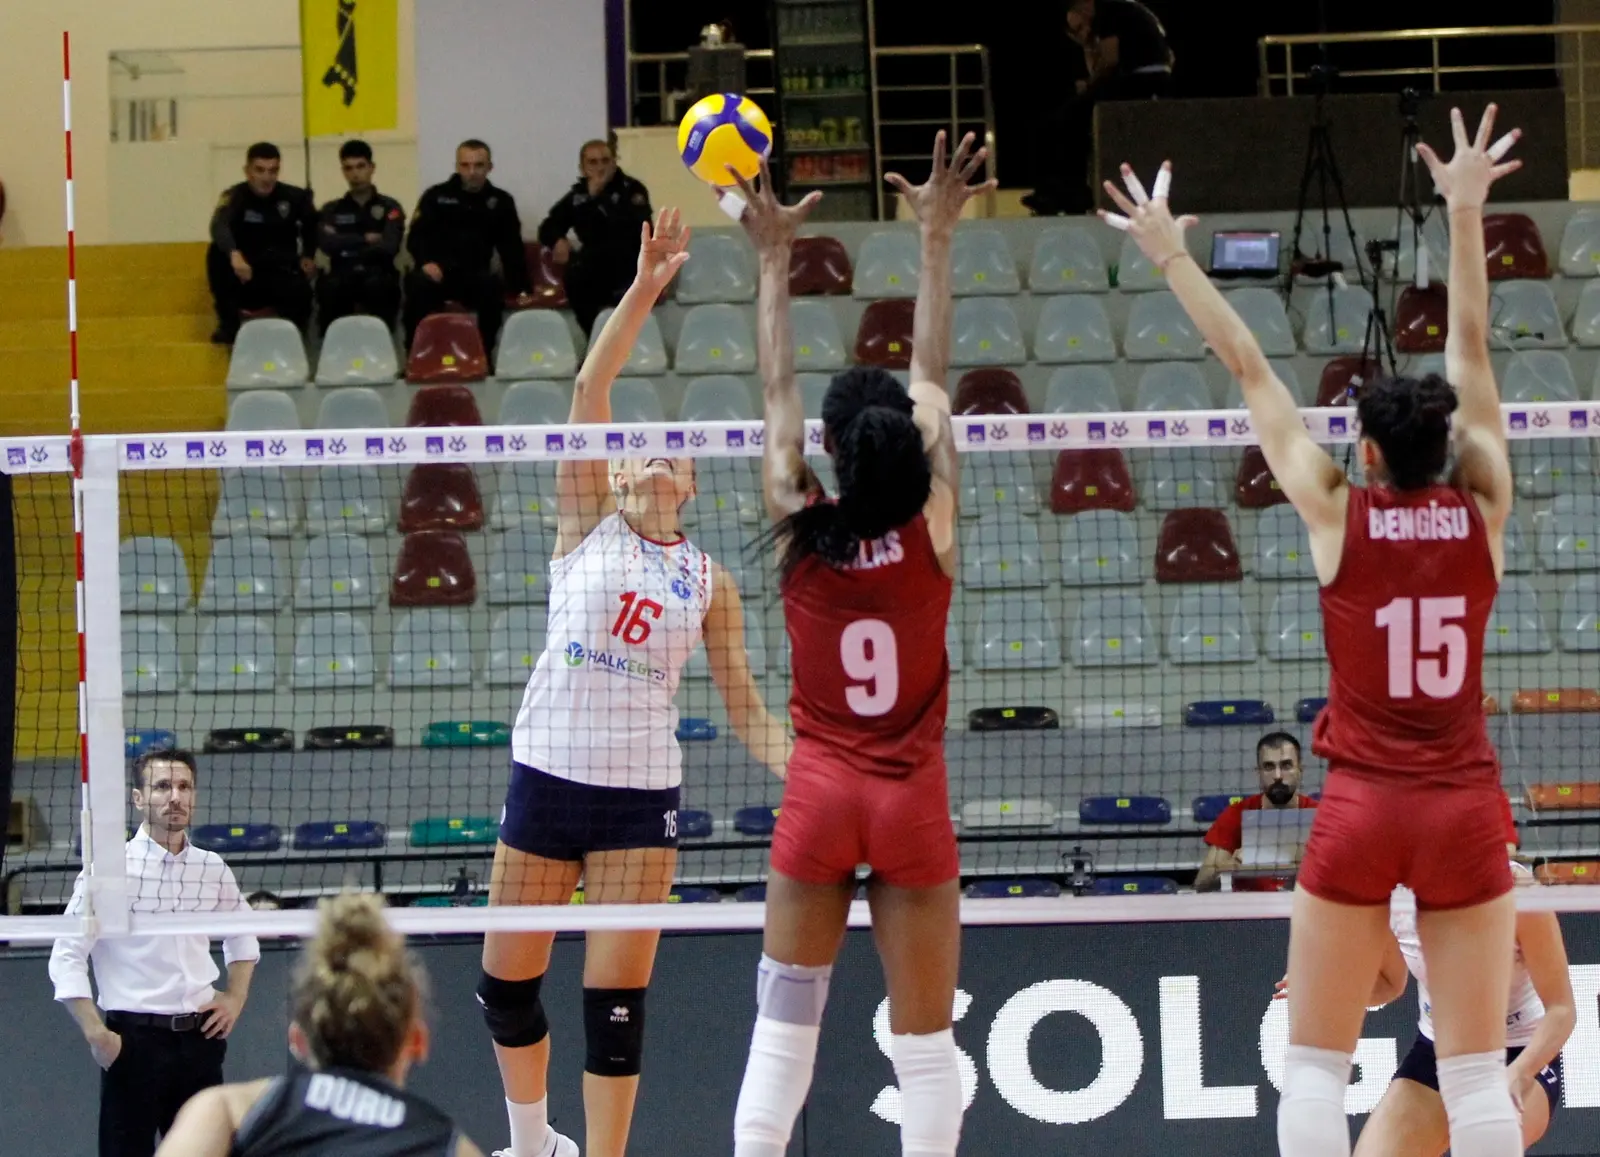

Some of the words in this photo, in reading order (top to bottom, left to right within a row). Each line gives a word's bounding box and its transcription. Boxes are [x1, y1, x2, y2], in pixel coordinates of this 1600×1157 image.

[1369, 499, 1470, 540] BENGİSU
[611, 591, 663, 645] 16
[1375, 595, 1468, 699] 15
[840, 618, 899, 717] 9
[663, 809, 677, 838] 16
[869, 964, 1600, 1124] SOLG
